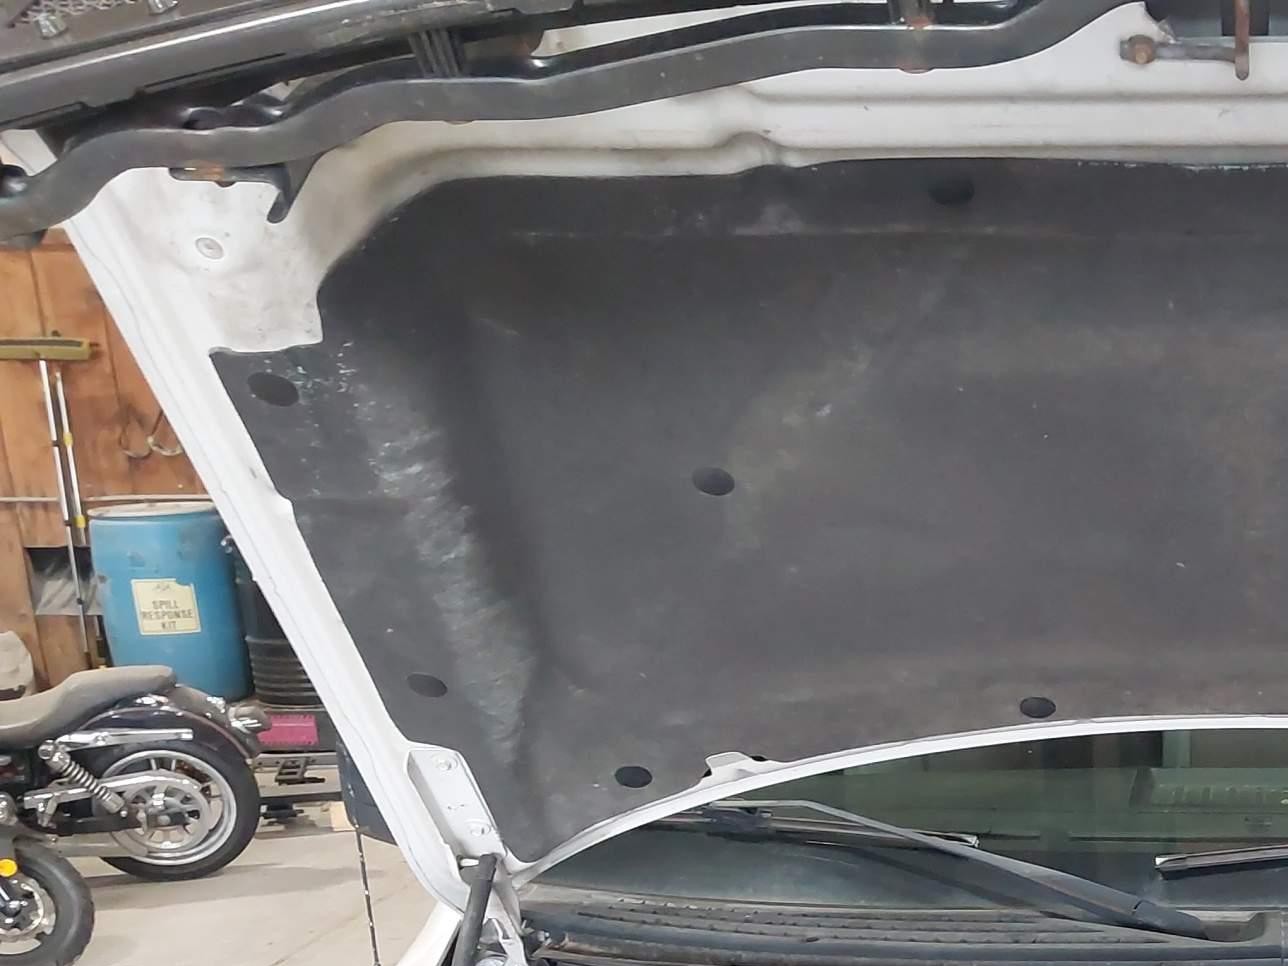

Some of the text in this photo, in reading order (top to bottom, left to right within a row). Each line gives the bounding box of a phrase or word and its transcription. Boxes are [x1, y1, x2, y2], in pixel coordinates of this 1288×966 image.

[151, 600, 178, 609] SPILL
[141, 609, 193, 620] RESPONSE
[161, 621, 177, 630] KIT
